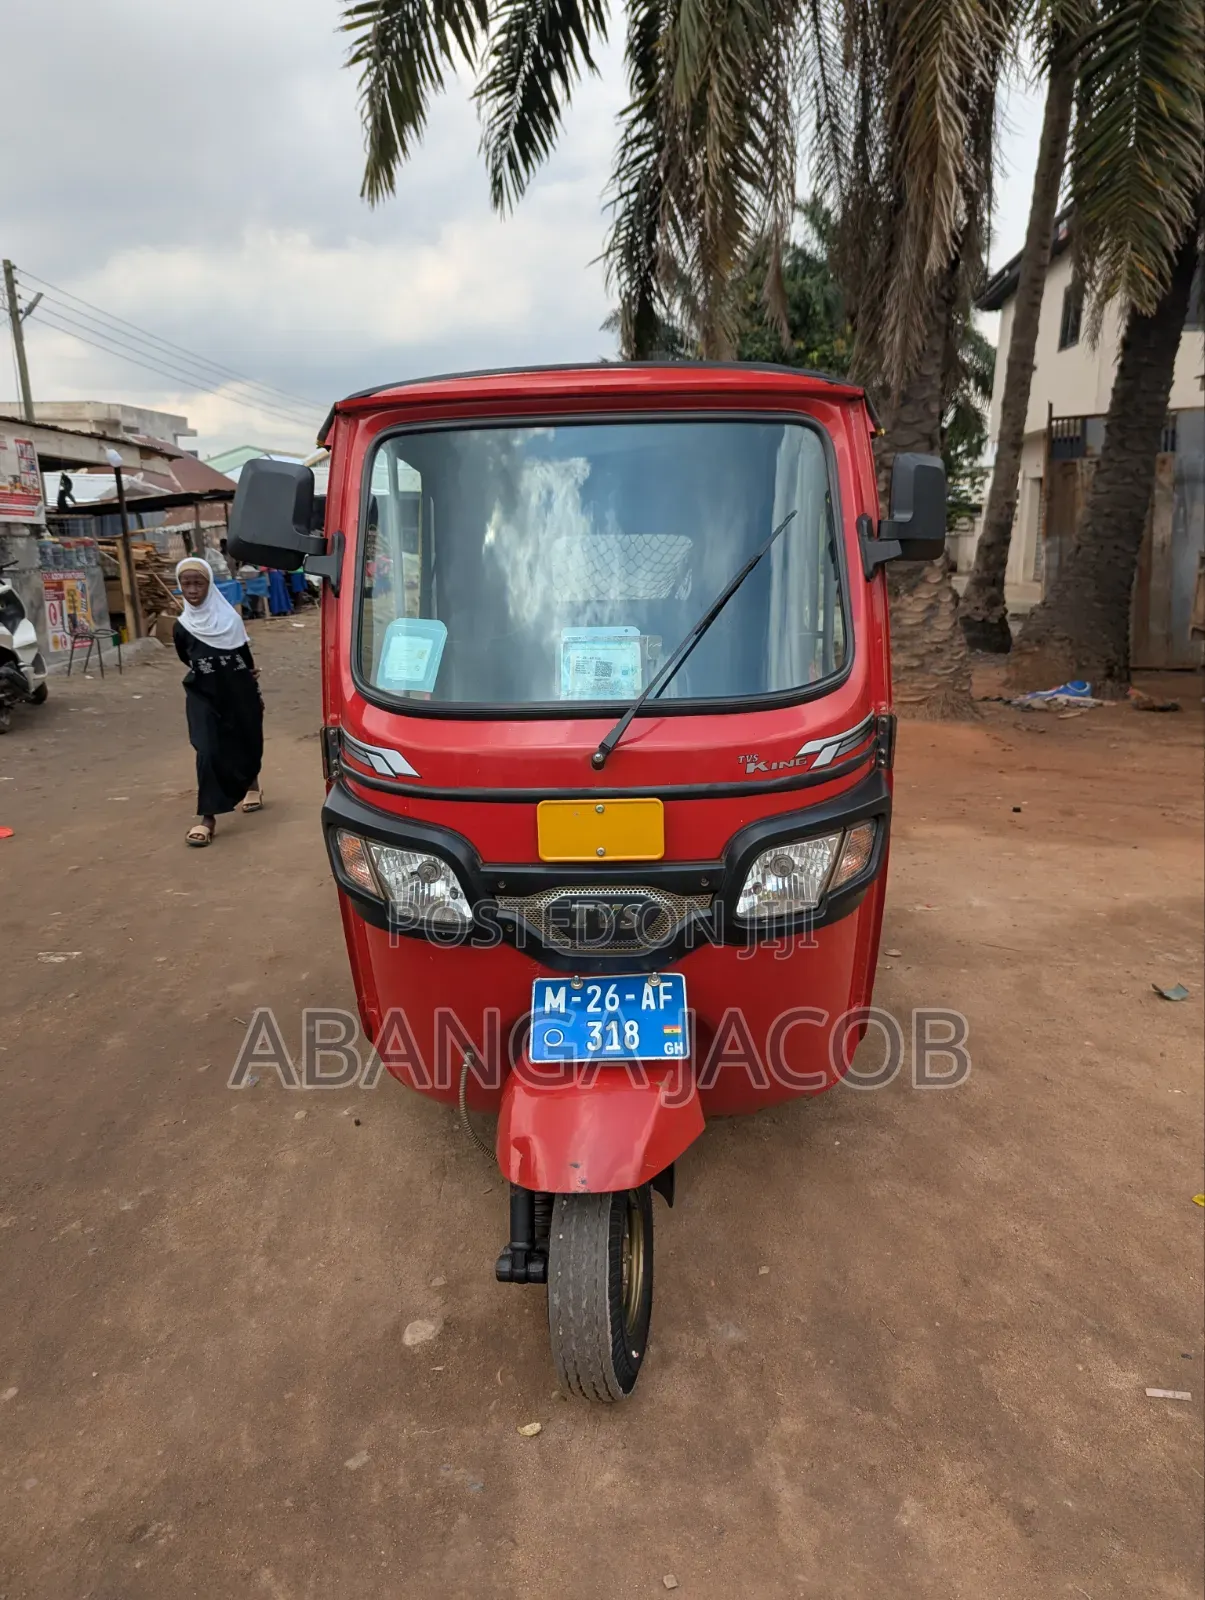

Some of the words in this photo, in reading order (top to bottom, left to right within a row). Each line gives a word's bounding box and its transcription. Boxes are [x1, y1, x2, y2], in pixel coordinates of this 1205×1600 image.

[738, 753, 759, 764] TVS
[745, 756, 807, 774] KING
[571, 903, 640, 929] TVS
[543, 981, 673, 1014] M-26-AF
[586, 1019, 640, 1051] 318
[663, 1041, 684, 1055] GH
